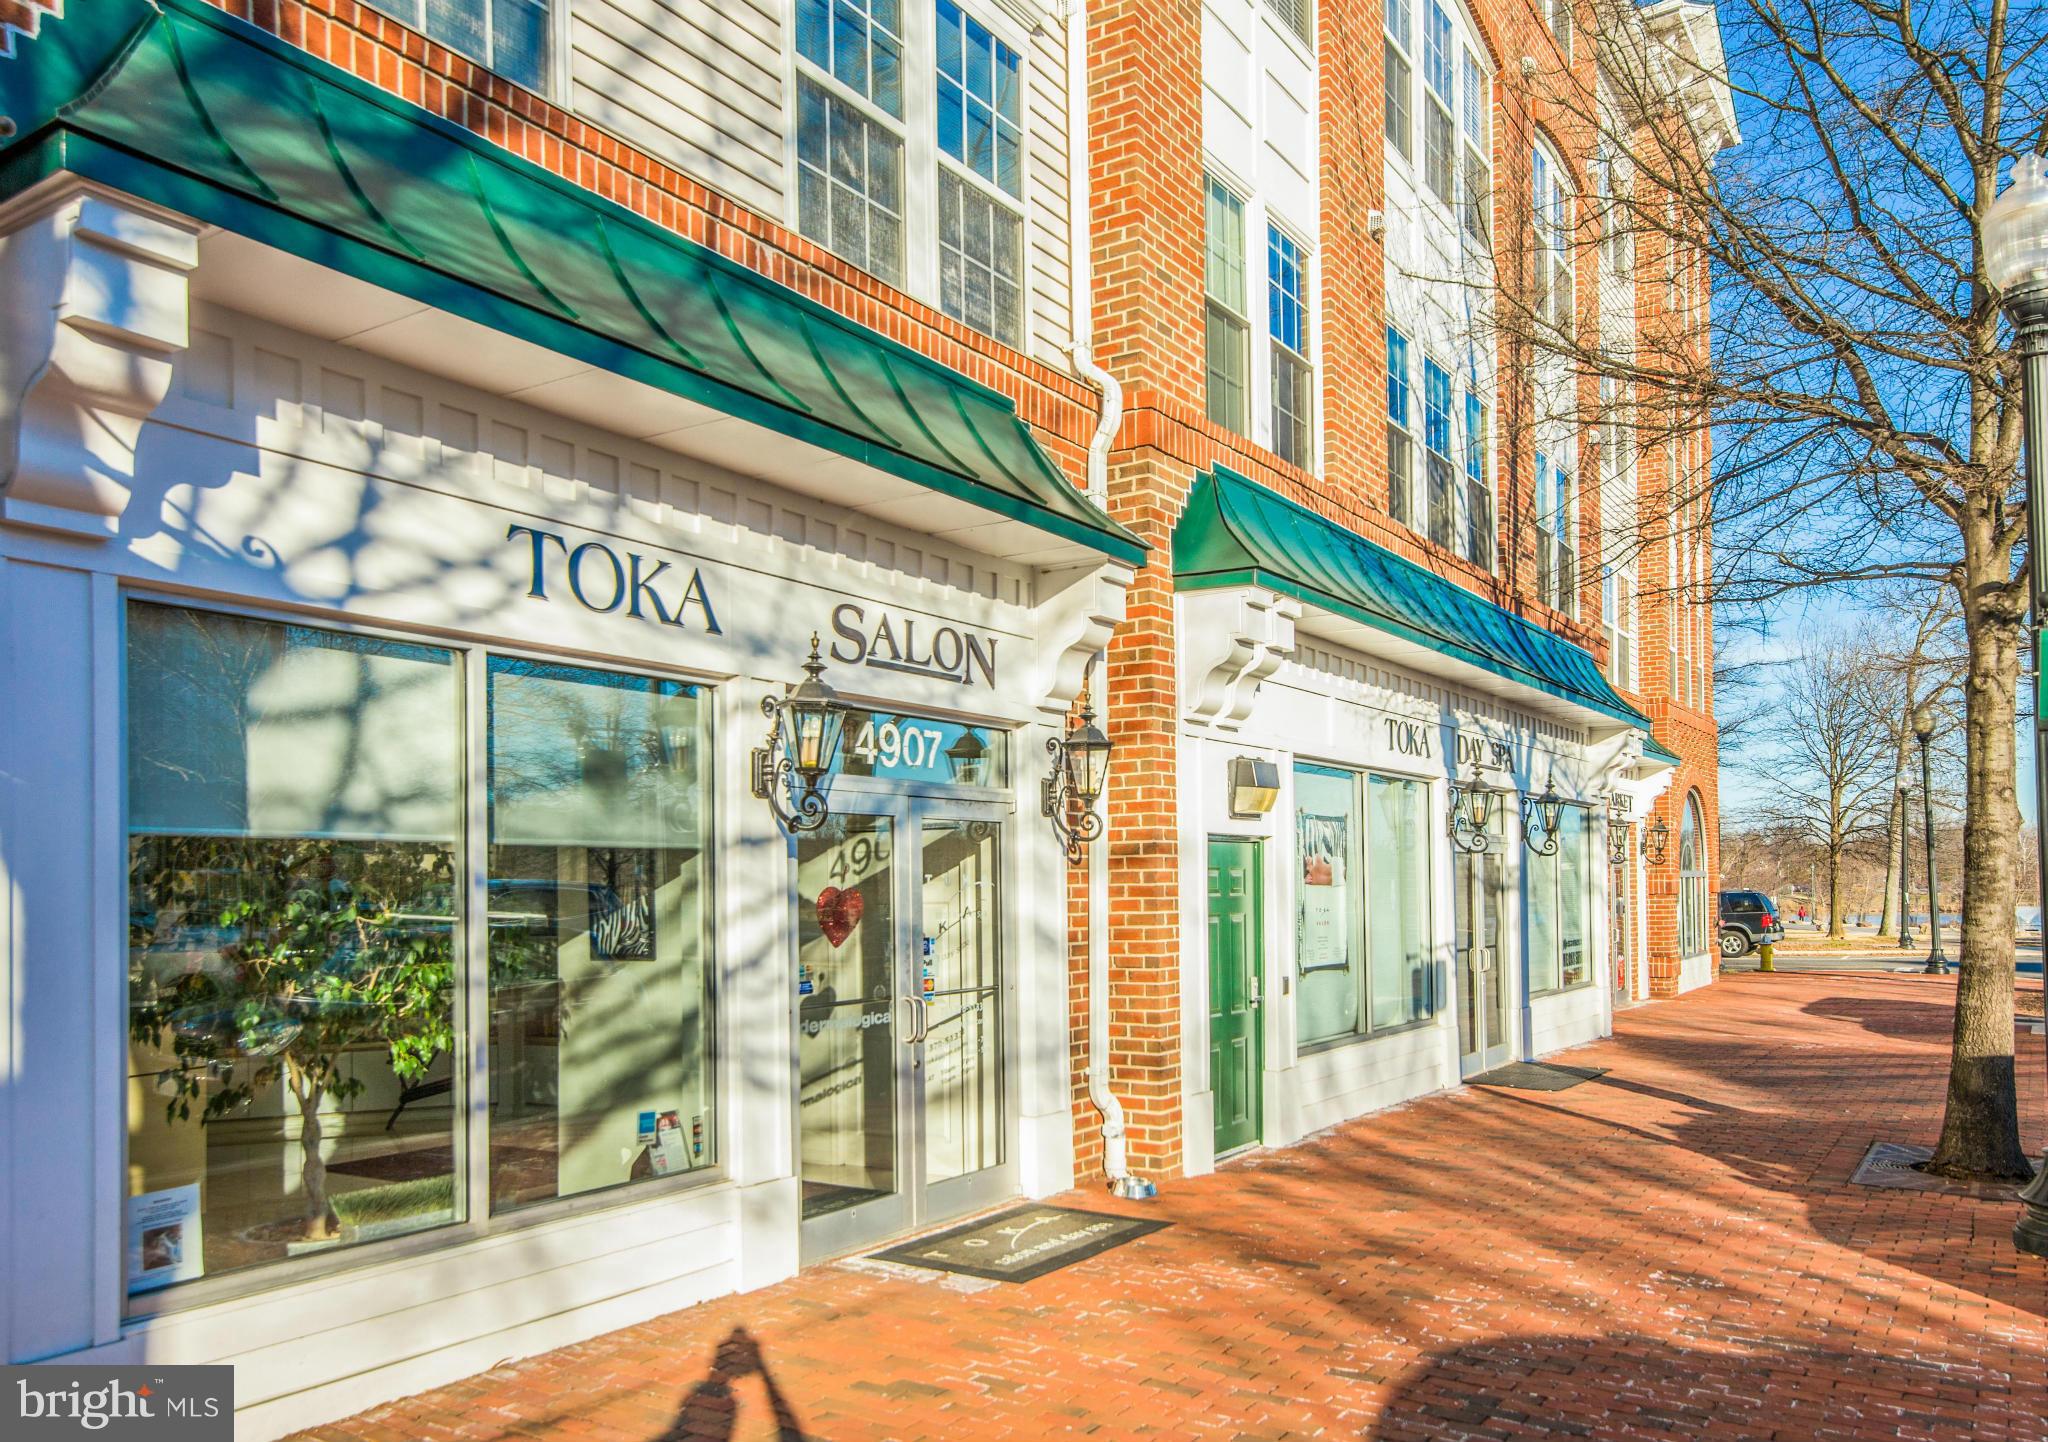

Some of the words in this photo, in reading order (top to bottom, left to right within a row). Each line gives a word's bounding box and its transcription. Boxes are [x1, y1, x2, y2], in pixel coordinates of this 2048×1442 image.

[506, 524, 723, 636] TOKA
[830, 603, 999, 690] SALON
[855, 721, 943, 769] 4907
[1384, 717, 1432, 759] TOKA
[1457, 734, 1485, 765] DAY
[1491, 742, 1516, 773] SPA
[1610, 792, 1633, 812] ARKET
